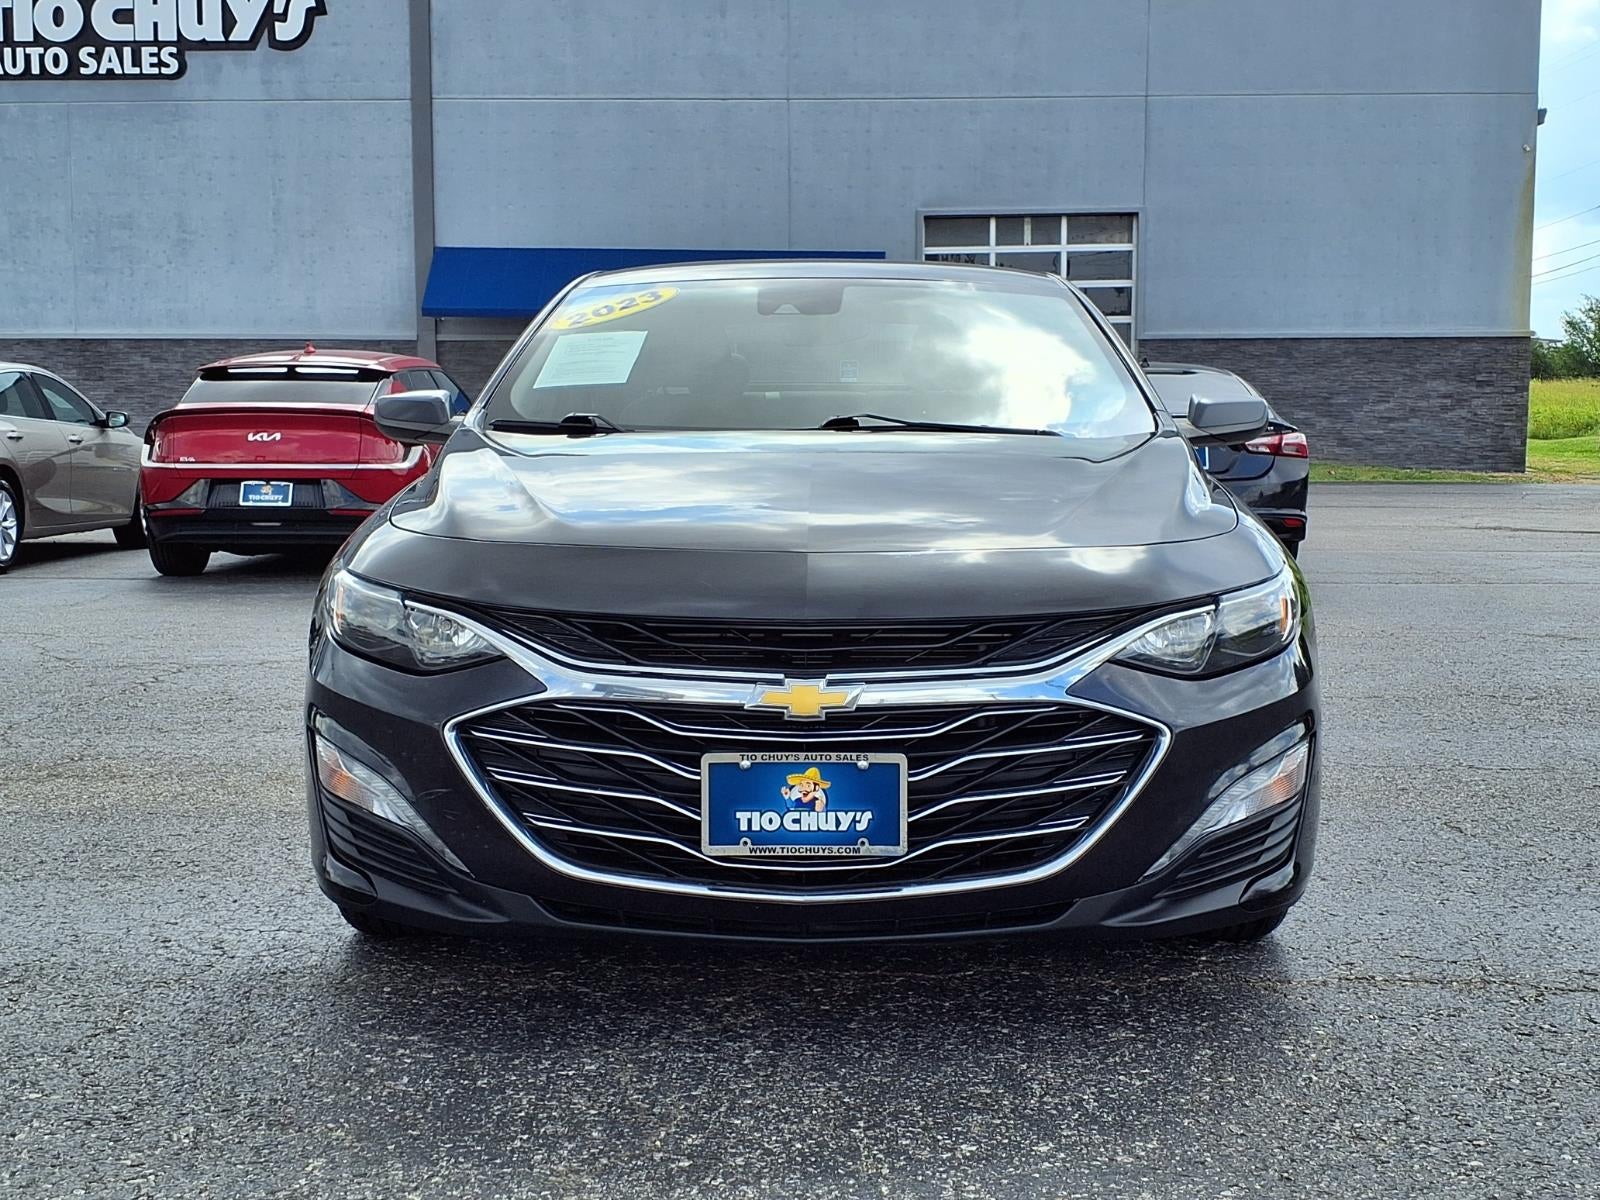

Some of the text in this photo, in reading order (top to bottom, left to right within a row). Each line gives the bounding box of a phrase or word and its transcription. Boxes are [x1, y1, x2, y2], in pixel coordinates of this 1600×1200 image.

[0, 46, 179, 75] UTO SALES
[567, 291, 661, 327] 2023
[740, 753, 869, 761] TIO CHUY'S AUTO SALES
